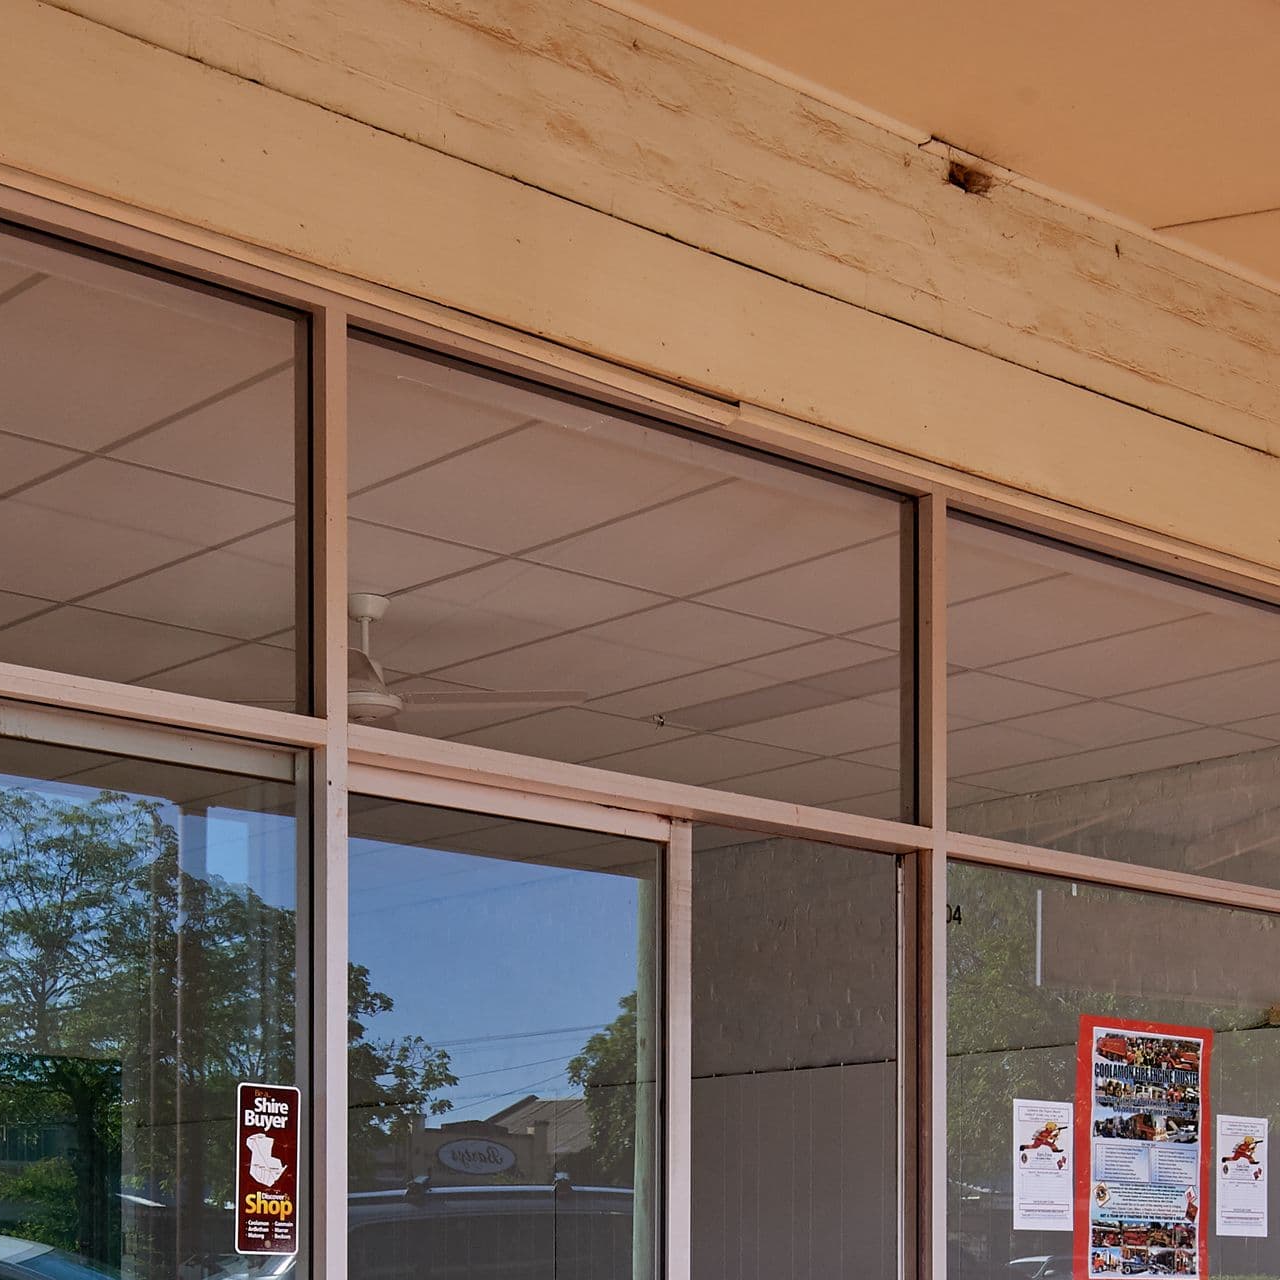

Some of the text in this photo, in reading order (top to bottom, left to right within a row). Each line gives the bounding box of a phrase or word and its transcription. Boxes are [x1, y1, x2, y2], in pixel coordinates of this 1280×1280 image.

[1094, 1062, 1133, 1079] COOLAMON
[254, 1097, 289, 1114] Shire
[244, 1109, 288, 1132] Buyer
[245, 1191, 293, 1221] Shop
